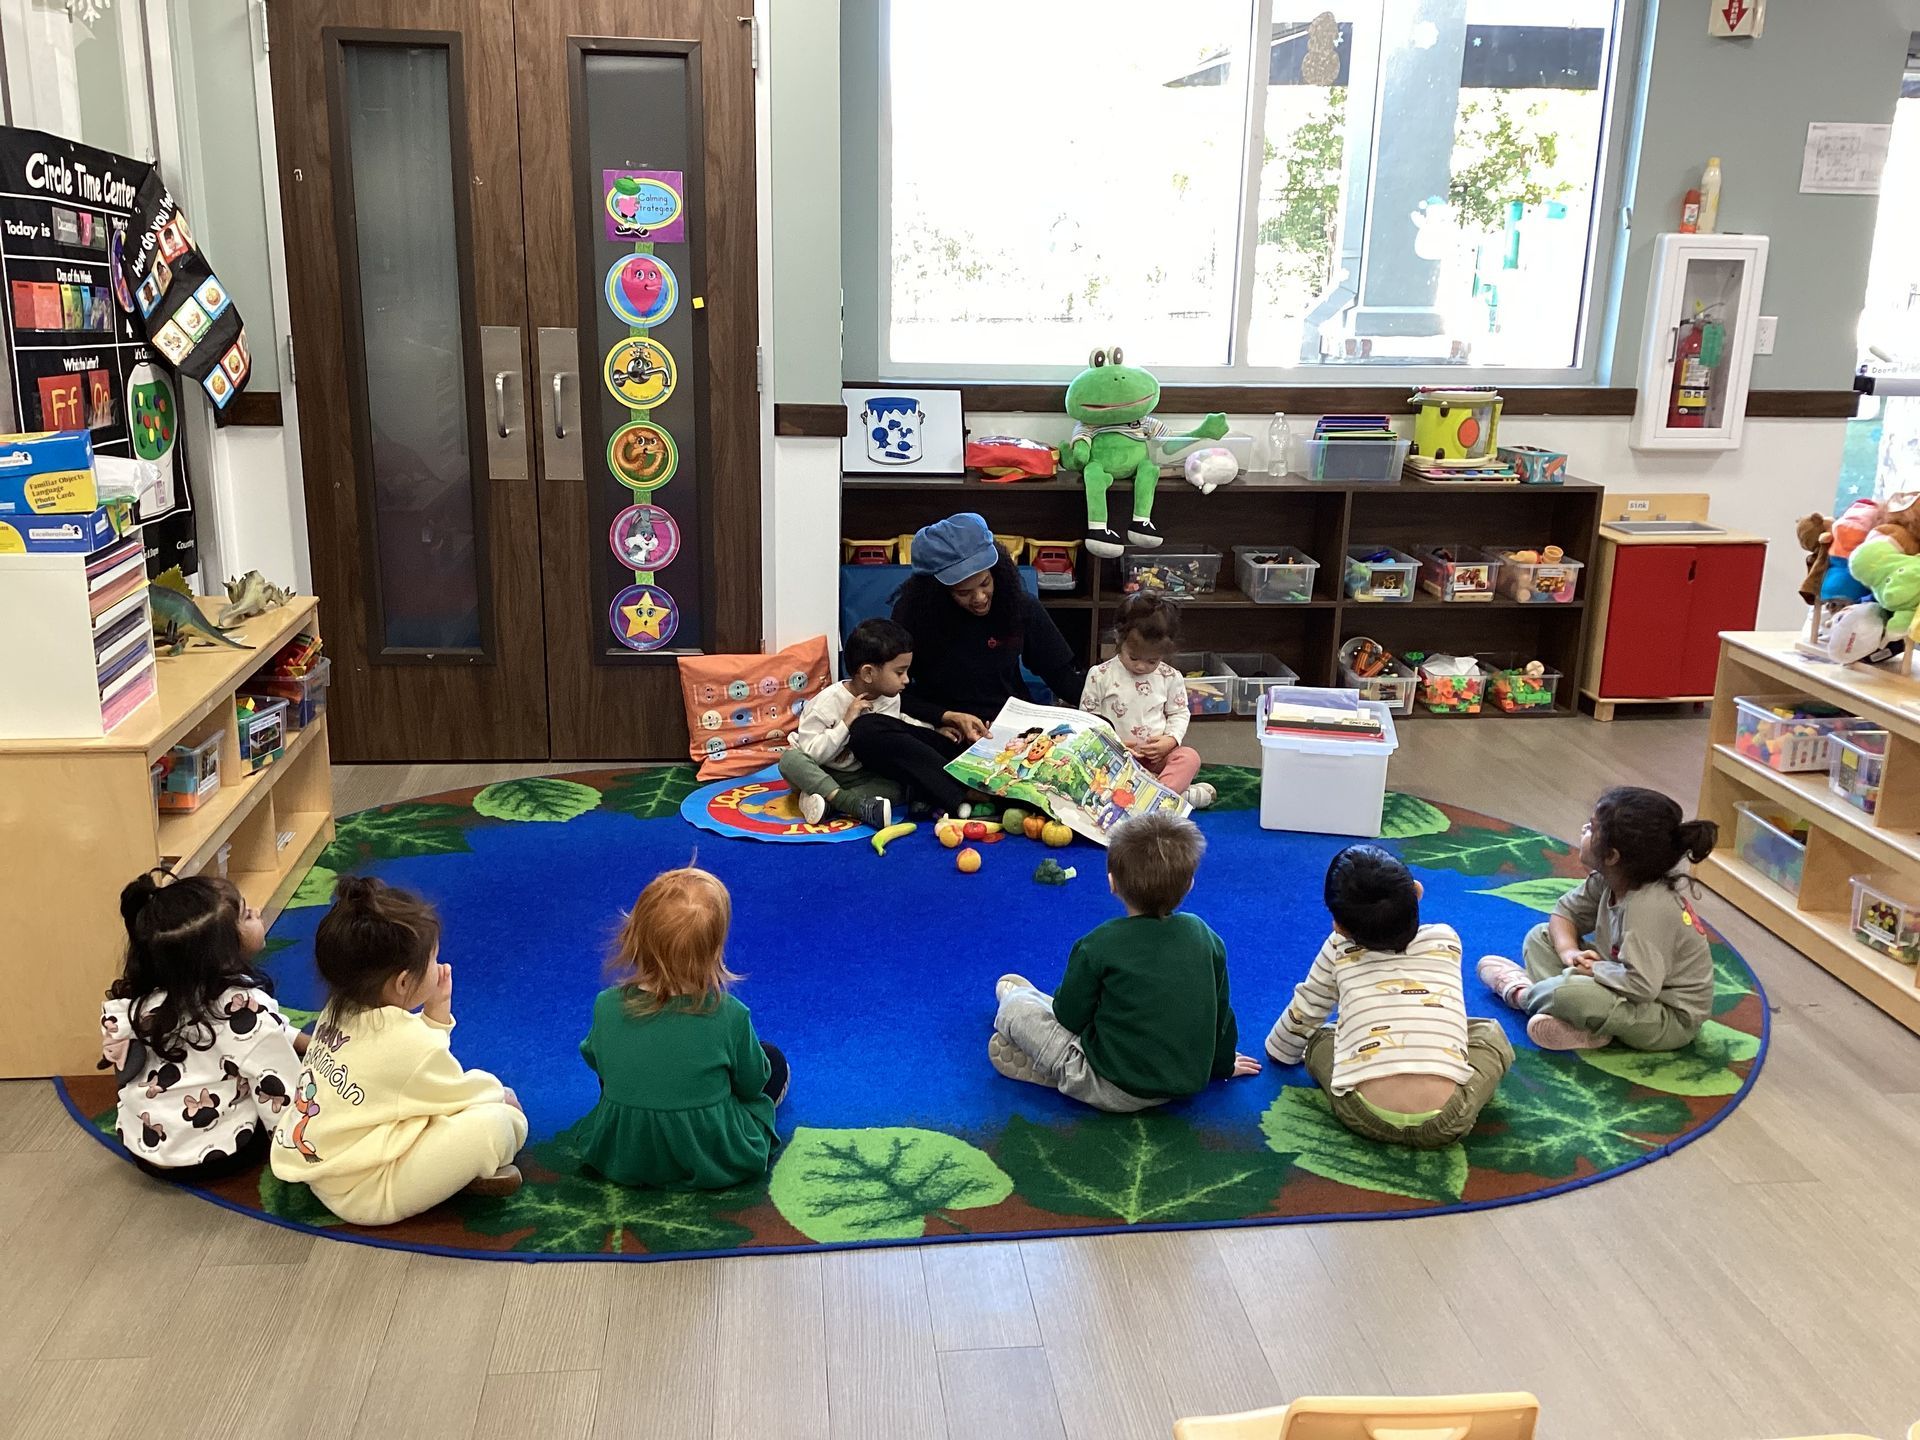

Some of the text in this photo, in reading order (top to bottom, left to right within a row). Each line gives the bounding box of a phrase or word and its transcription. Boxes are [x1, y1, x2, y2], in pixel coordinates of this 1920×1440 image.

[25, 152, 136, 209] Circle Time Center
[637, 192, 668, 206] Calming
[634, 203, 674, 216] Strategies
[5, 219, 39, 239] Today
[41, 222, 51, 237] is
[131, 247, 147, 278] How
[140, 231, 157, 251] do
[150, 208, 170, 231] you
[29, 473, 84, 490] Familiar Objects
[32, 486, 64, 497] Language
[34, 491, 75, 504] Photo Cards
